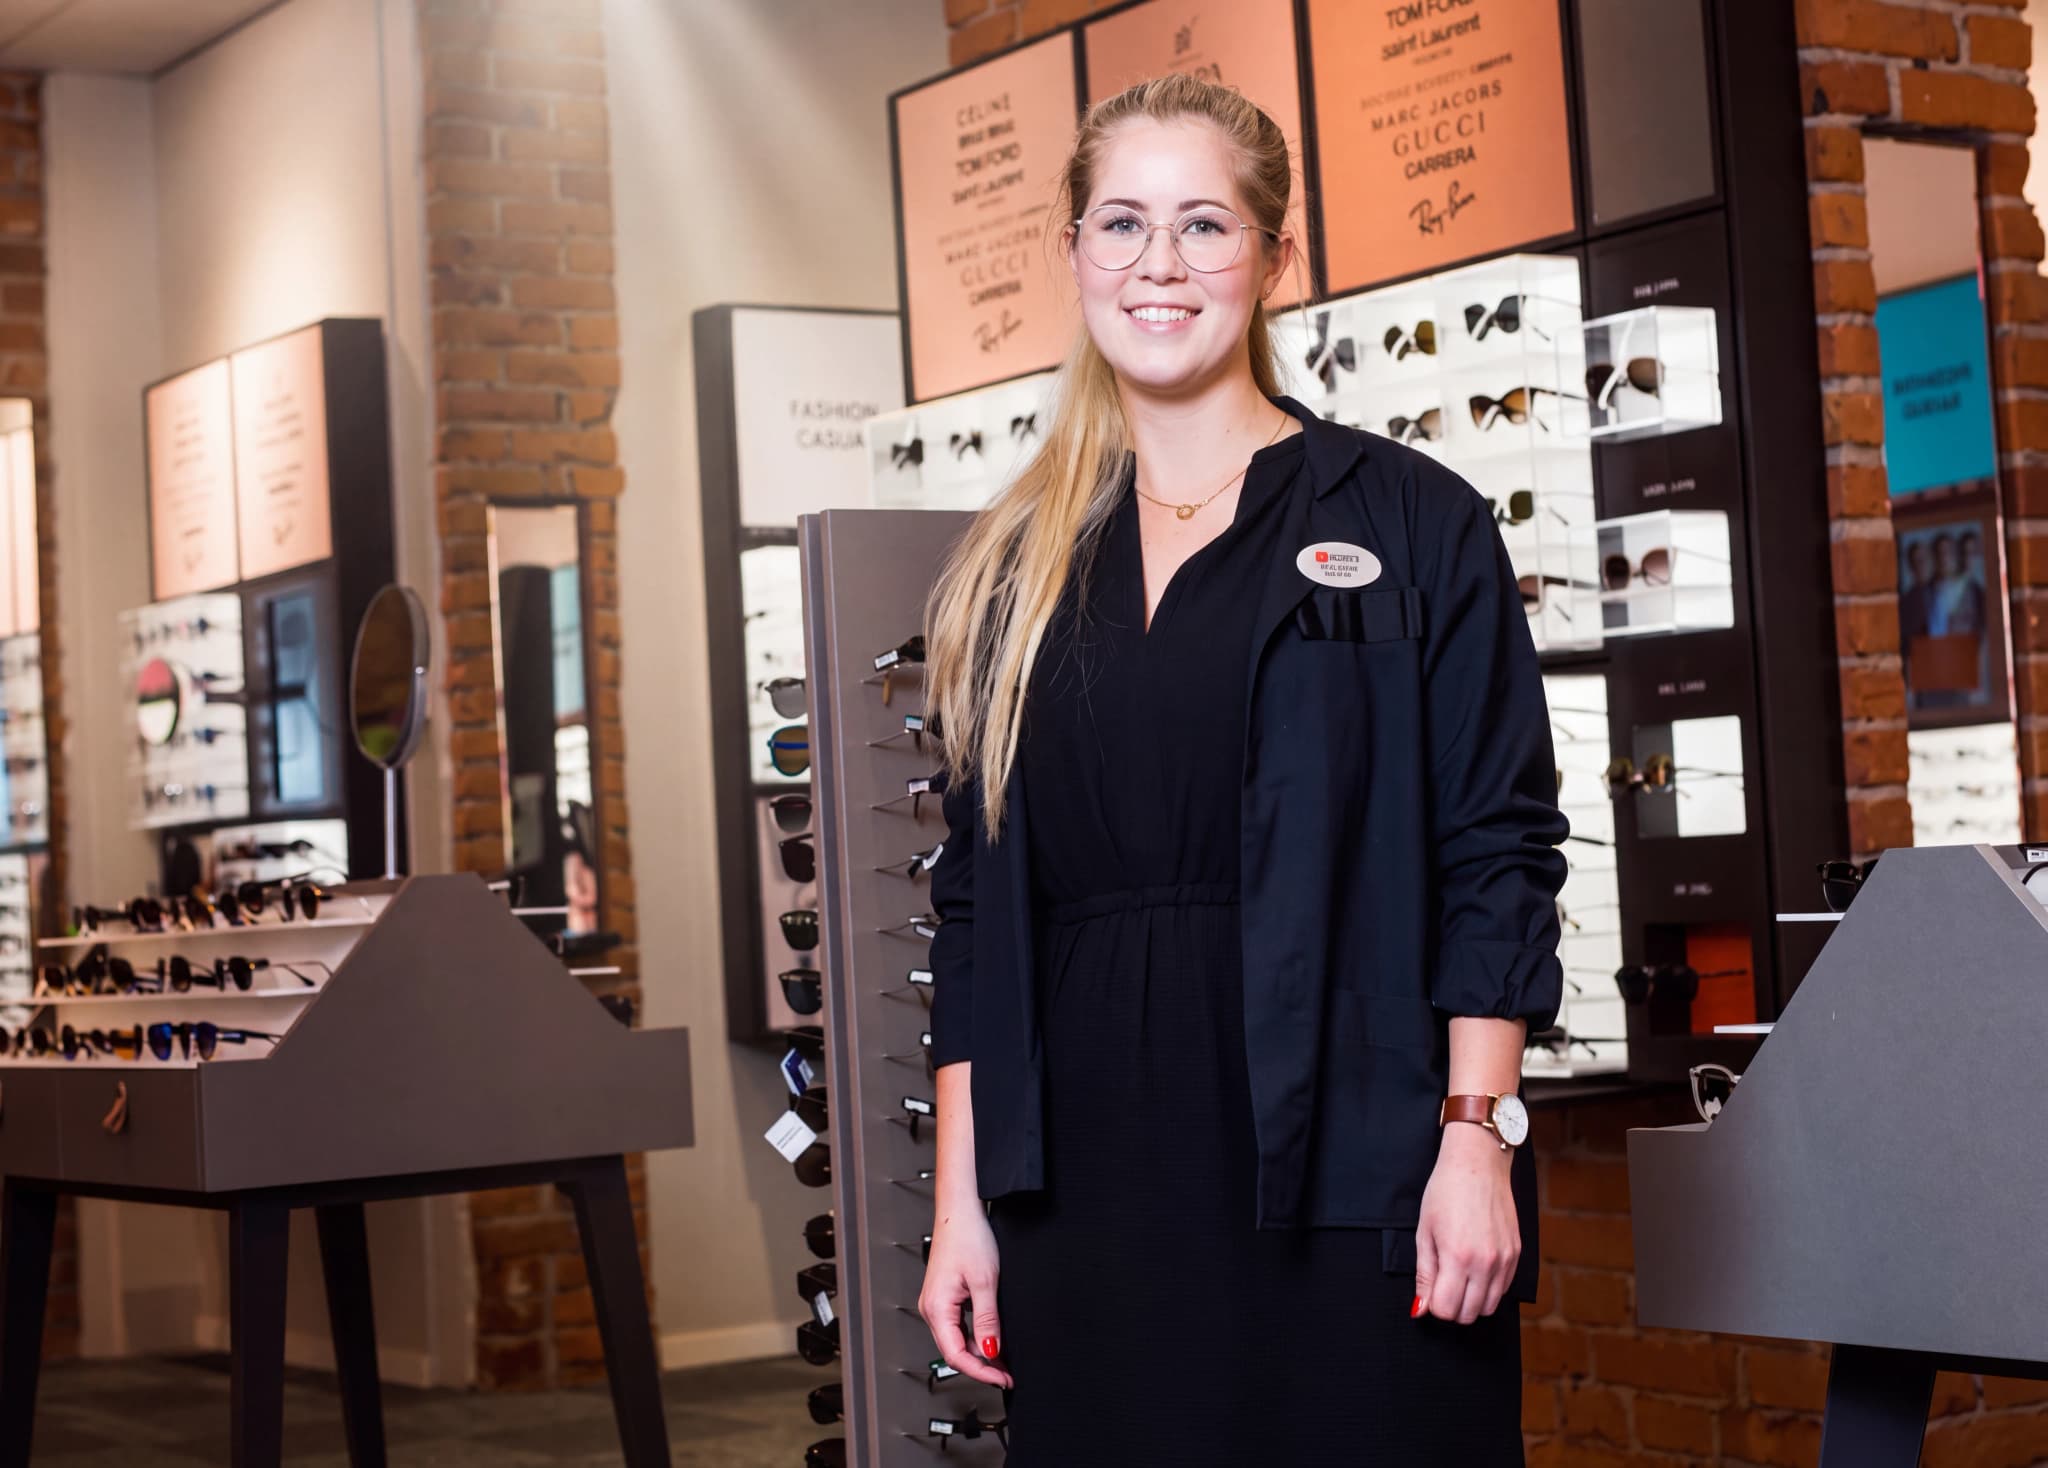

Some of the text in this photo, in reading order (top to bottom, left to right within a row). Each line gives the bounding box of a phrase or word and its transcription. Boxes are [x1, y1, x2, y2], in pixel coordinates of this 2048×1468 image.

[1386, 1, 1424, 29] TOM
[1371, 103, 1420, 131] MARC
[1392, 110, 1485, 157] GUCCI
[1404, 145, 1476, 180] CARRERA
